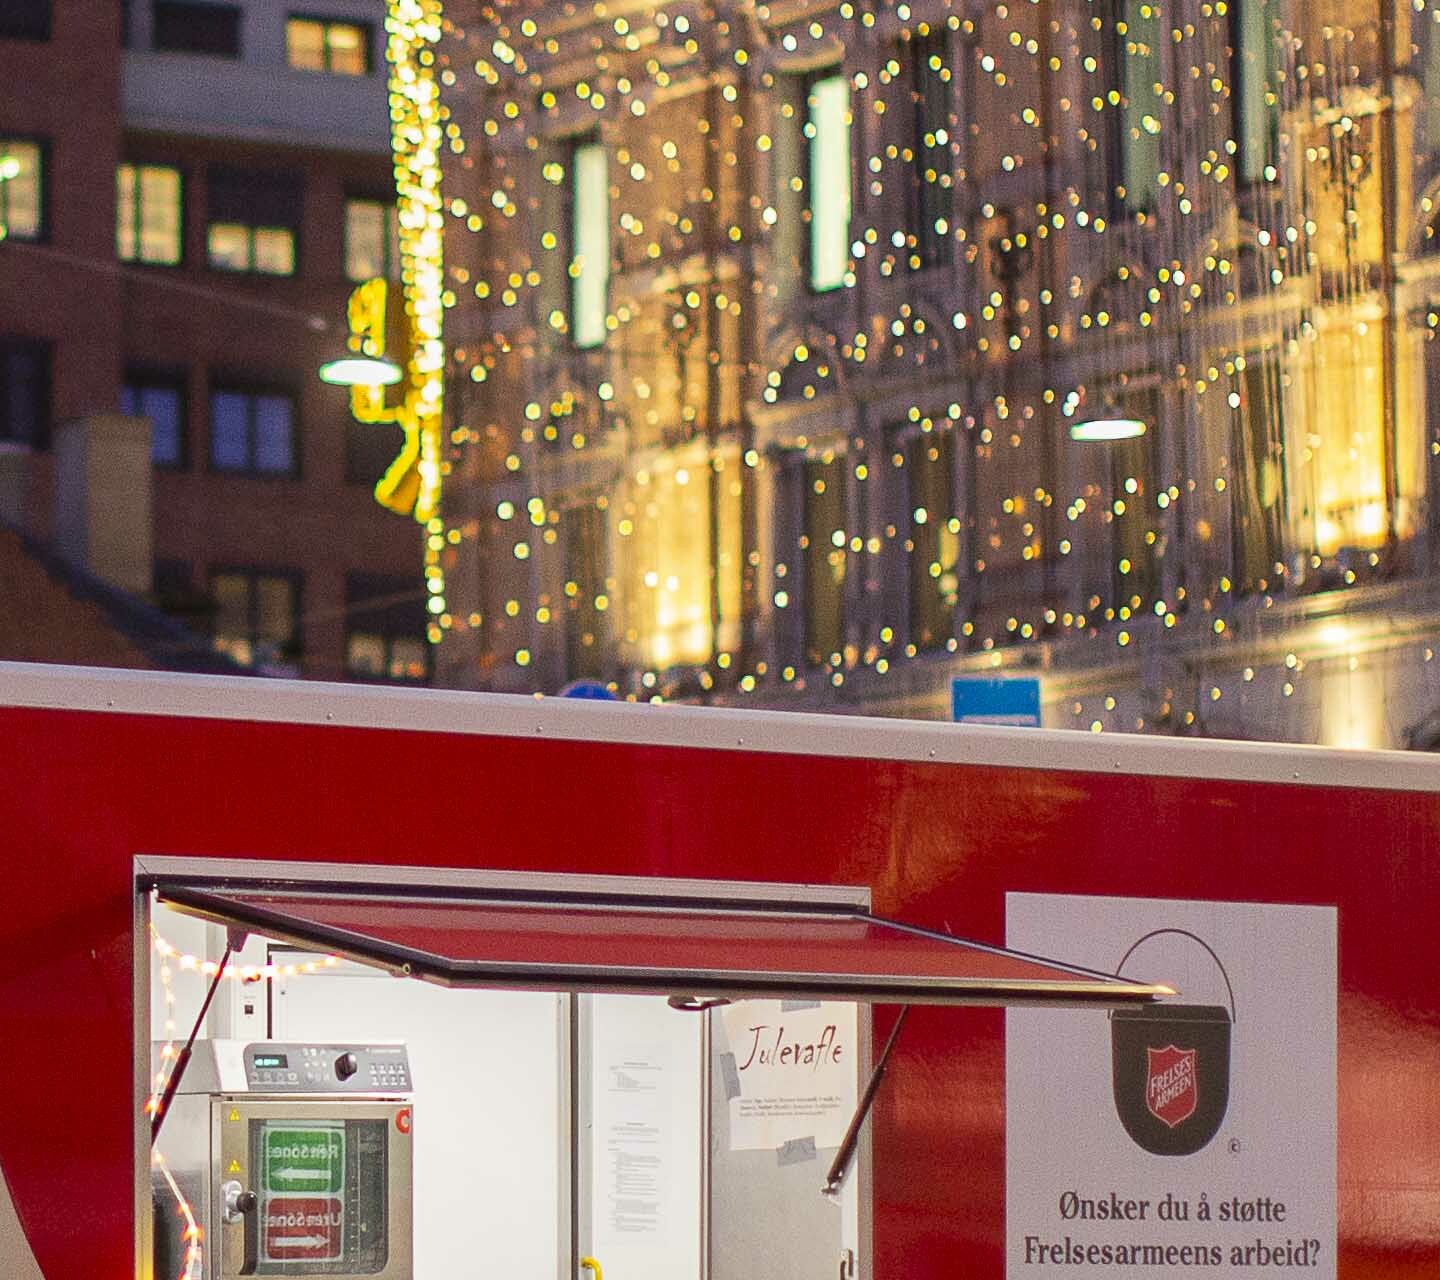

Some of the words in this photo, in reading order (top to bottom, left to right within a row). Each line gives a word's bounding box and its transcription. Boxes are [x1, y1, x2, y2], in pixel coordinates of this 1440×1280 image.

[1059, 1189, 1150, 1221] Ønsker
[1157, 1193, 1189, 1221] du
[1197, 1191, 1212, 1221] å
[1219, 1196, 1287, 1223] støtte
[1023, 1236, 1223, 1266] Frelsesarmeens
[1230, 1238, 1321, 1267] arbeid?
